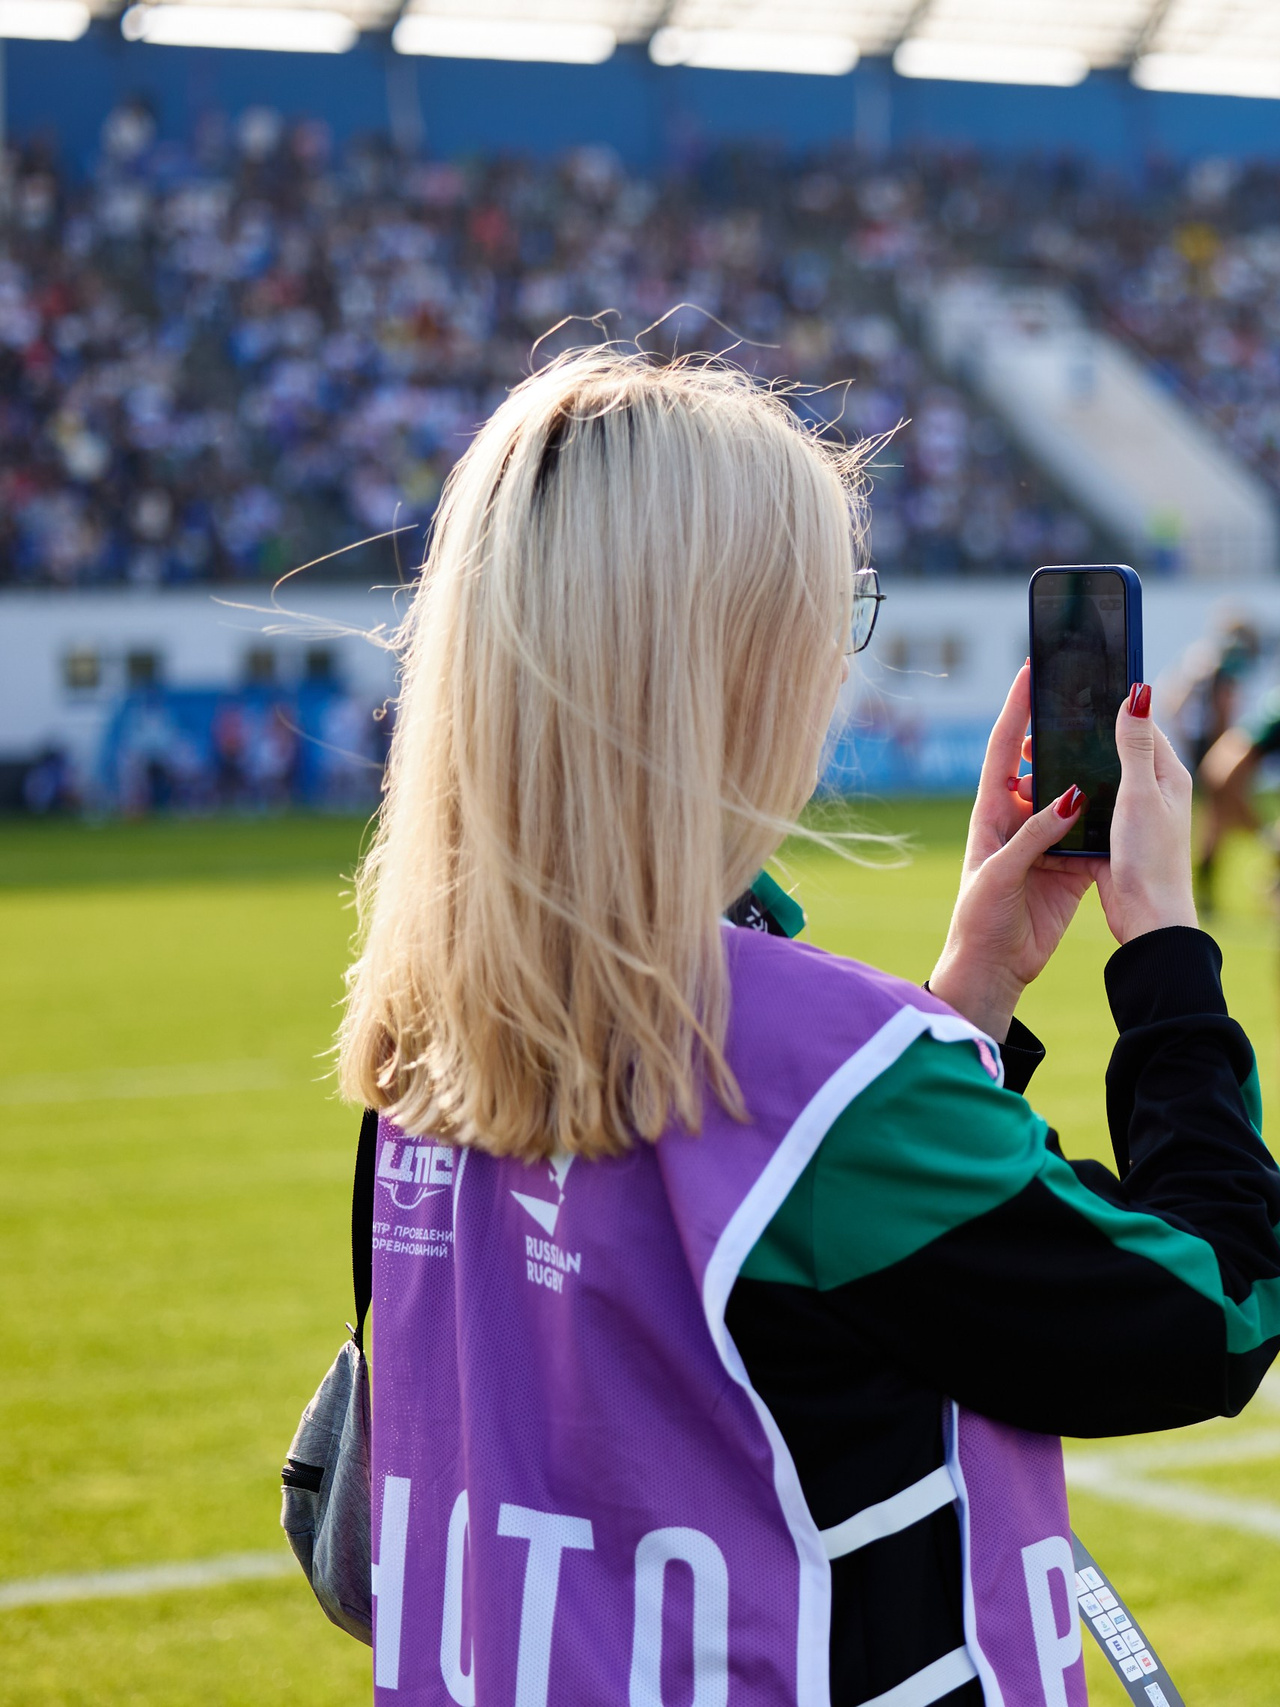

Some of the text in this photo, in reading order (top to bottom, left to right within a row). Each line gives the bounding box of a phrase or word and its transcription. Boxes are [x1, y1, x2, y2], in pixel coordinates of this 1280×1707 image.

[376, 1140, 454, 1185] ЦПС
[372, 1237, 448, 1258] ОРЕВНОВАНИЙ
[394, 1225, 454, 1244] ПРОВЕДЕНИ
[525, 1234, 582, 1275] RUSSIAN
[526, 1259, 564, 1294] RUGBY
[371, 1475, 729, 1707] HOTO
